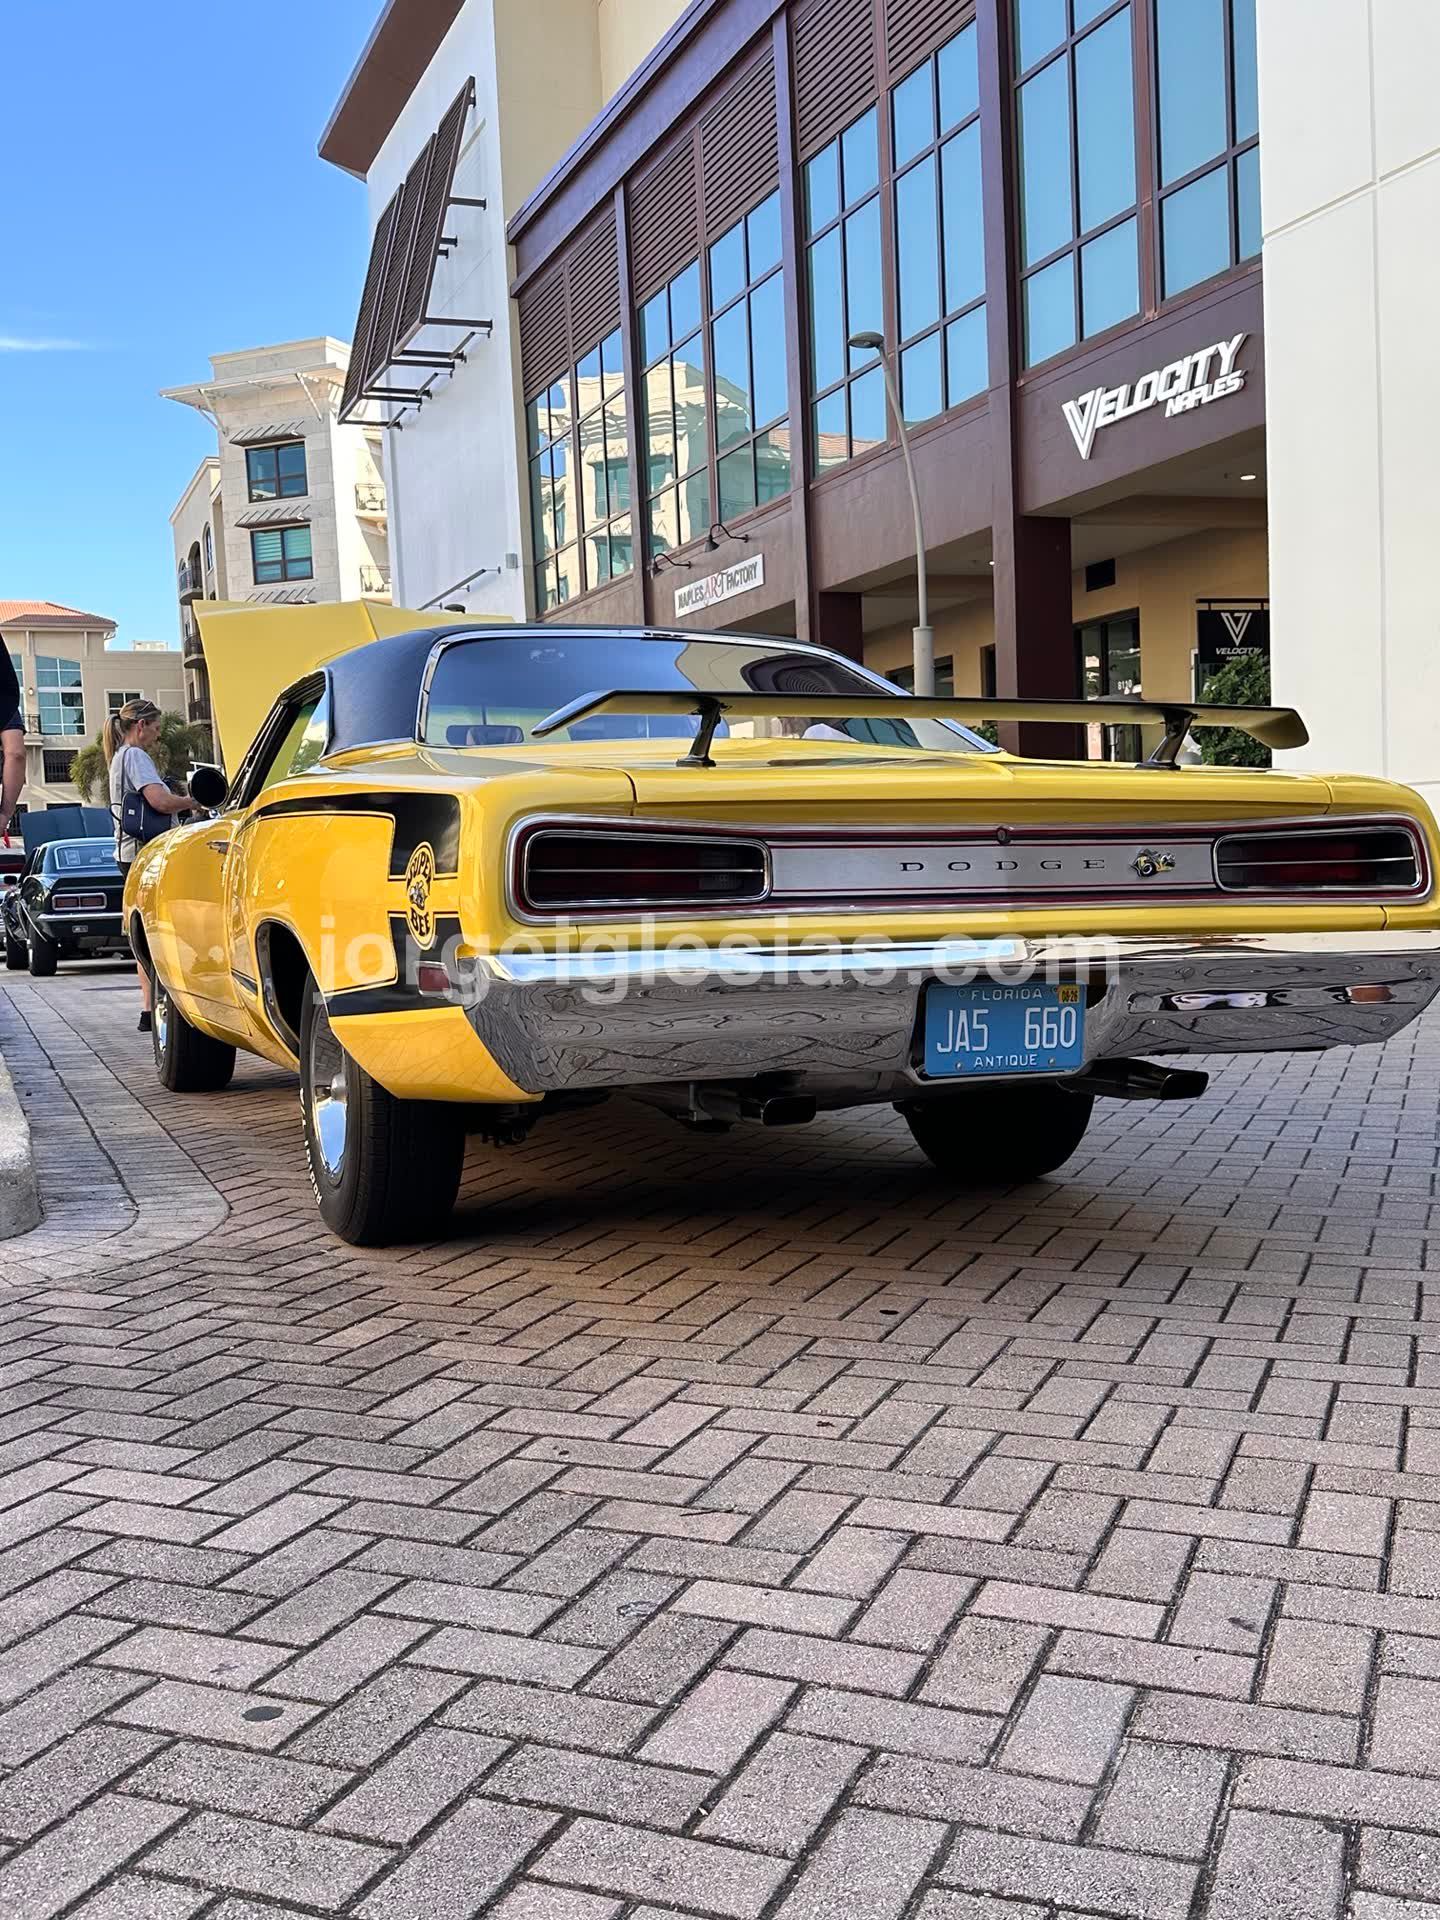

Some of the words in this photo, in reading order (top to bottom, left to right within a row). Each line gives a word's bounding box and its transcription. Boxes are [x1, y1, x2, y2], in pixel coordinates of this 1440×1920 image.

[1061, 333, 1248, 460] VELOCITY
[1165, 369, 1247, 418] NAPLES
[678, 585, 704, 609] NAPLES
[703, 571, 728, 599] ART
[726, 562, 758, 591] FACTORY
[1215, 647, 1264, 656] VELOCITY
[900, 860, 1106, 872] DODGE
[411, 907, 430, 937] BEE
[971, 988, 1042, 1001] FLORIDA
[936, 1009, 989, 1053] JA5
[1024, 1006, 1077, 1050] 660
[974, 1053, 1037, 1068] ANTIQUE
